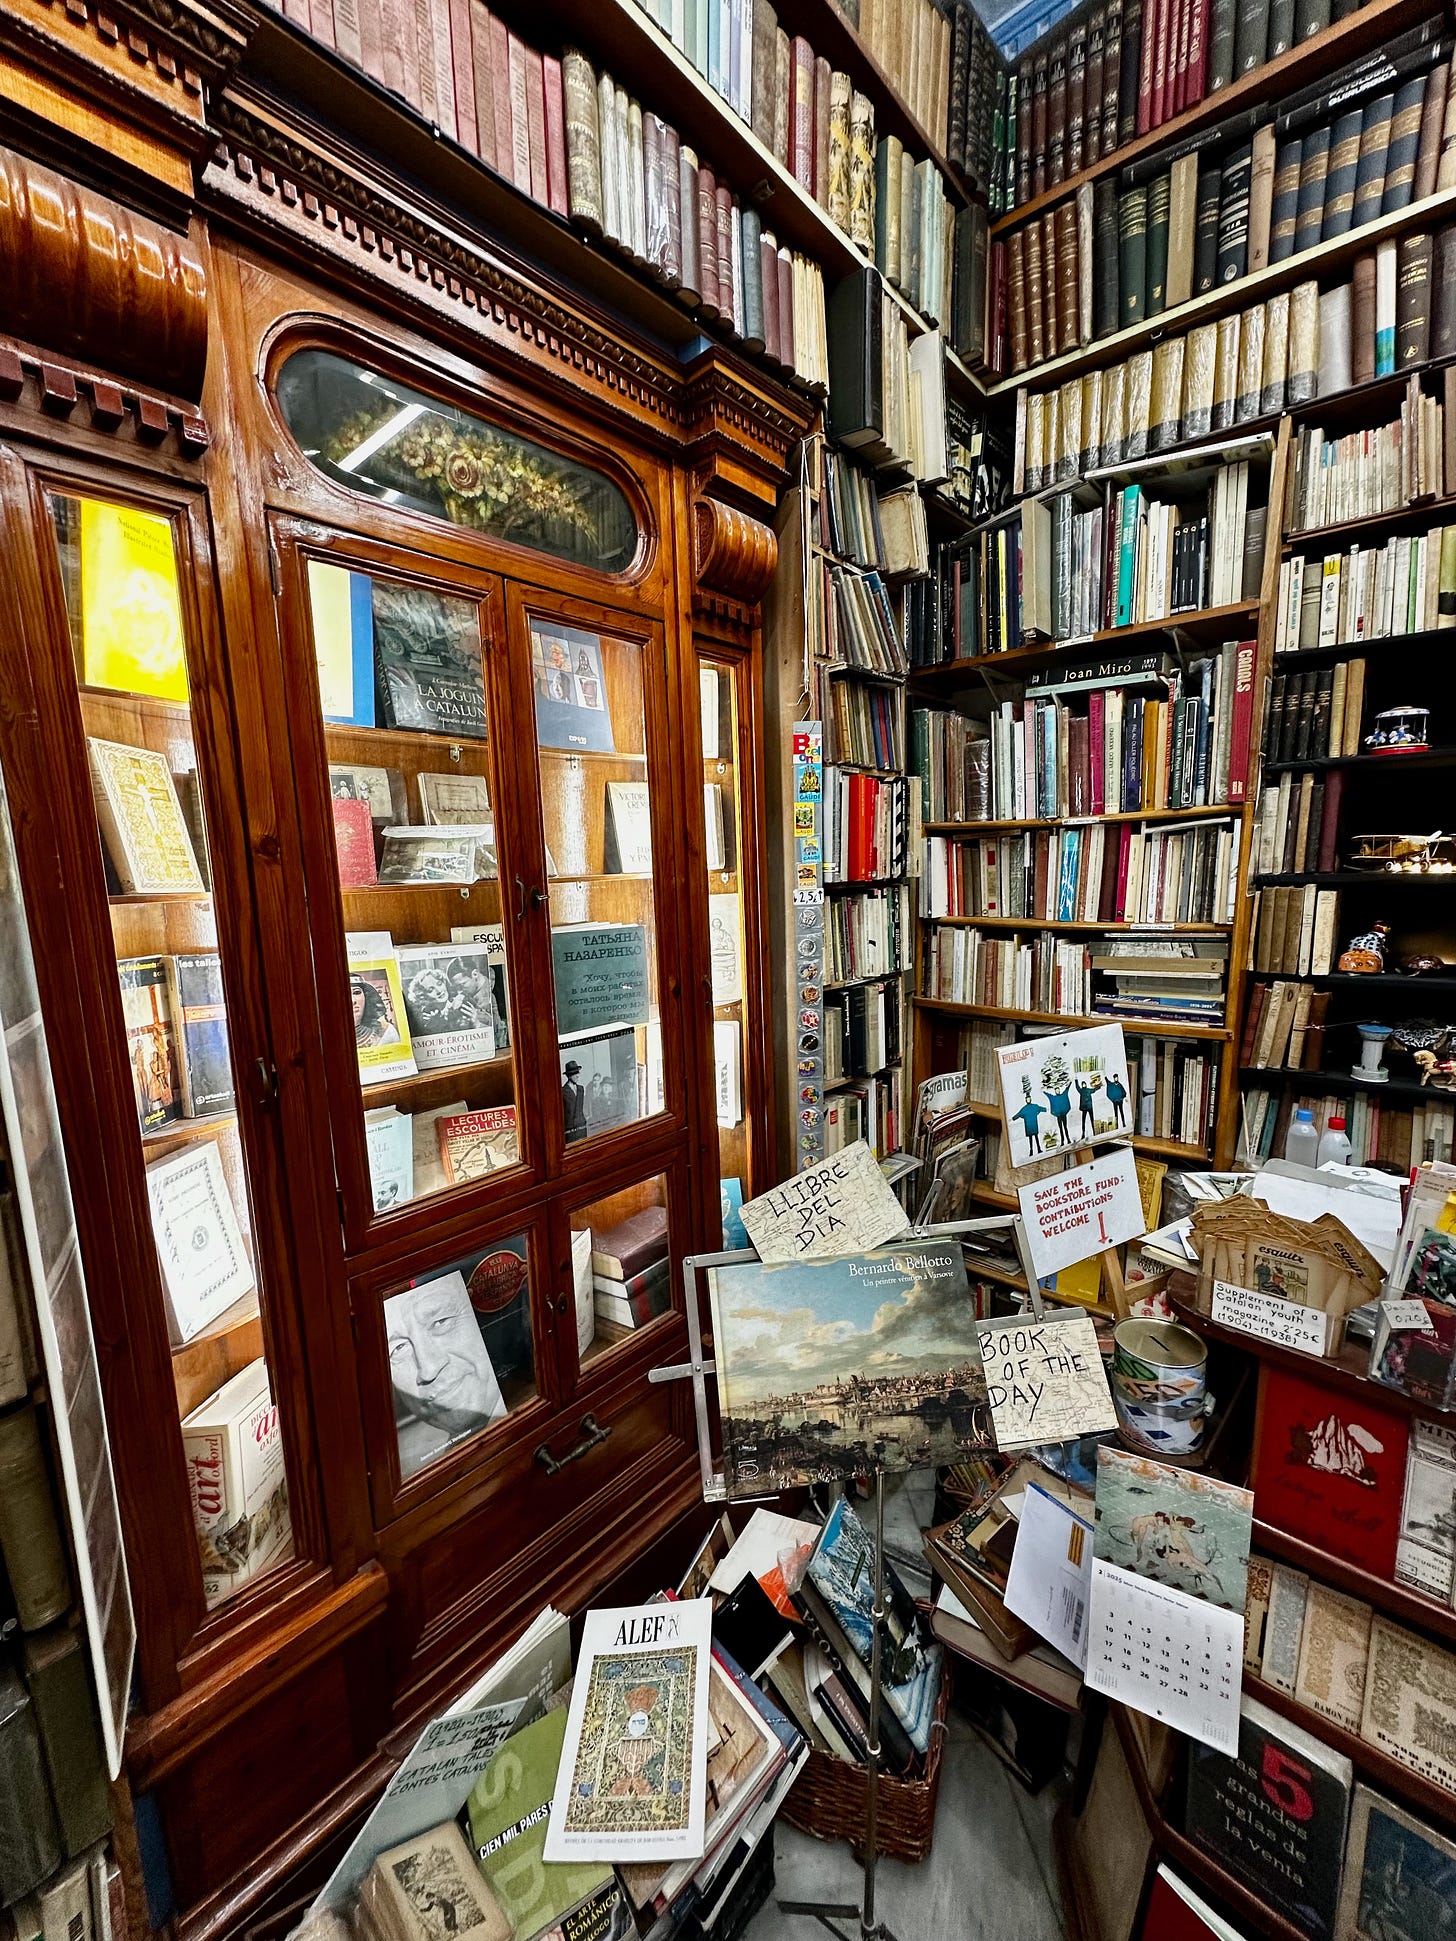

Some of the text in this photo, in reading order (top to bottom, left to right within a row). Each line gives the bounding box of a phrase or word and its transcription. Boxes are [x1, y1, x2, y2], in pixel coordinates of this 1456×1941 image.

[1063, 659, 1132, 683] Joan Miró
[417, 684, 486, 703] LA JOGUIN
[414, 700, 487, 719] A CATALUN
[564, 945, 642, 962] НАЗАРЕНКО
[582, 931, 641, 947] ТАТЬЯНА
[426, 1042, 476, 1058] ET CINÉMA
[447, 1118, 516, 1136] ESCOLLIDES
[452, 1110, 508, 1127] LECTURES
[767, 1163, 850, 1218] LLIBRE
[1034, 1177, 1083, 1201] SAVE THE
[1036, 1175, 1125, 1213] BOOKSTORE FUND:
[797, 1194, 842, 1230] DEL
[1042, 1213, 1090, 1239] WELCOME
[795, 1216, 846, 1251] DIA
[473, 1261, 518, 1285] CATALUNYA
[848, 1254, 953, 1278] Bernardo Bellotto
[863, 1278, 874, 1288] Un
[875, 1275, 897, 1289] peintre
[898, 1273, 923, 1284] vénitien
[928, 1269, 954, 1280] Varsovie
[1216, 1282, 1318, 1321] Supplement of a
[1216, 1291, 1304, 1325] Catalan youth
[1223, 1305, 1275, 1328] magazine
[978, 1328, 1048, 1362] BOOK
[1003, 1354, 1089, 1381] OF THE
[988, 1382, 1044, 1422] DAY
[1107, 1572, 1122, 1584] 2025
[614, 1615, 666, 1646] ALEF
[803, 1611, 842, 1671] GOYA
[1105, 1625, 1114, 1633] 10
[1124, 1633, 1132, 1641] 11
[1142, 1641, 1151, 1649] 12
[1181, 1658, 1190, 1666] 14
[1201, 1667, 1210, 1675] 15
[1221, 1676, 1230, 1684] 16
[1103, 1654, 1188, 1697] 24 25 26 27 28
[1123, 1648, 1131, 1656] 18
[1142, 1656, 1150, 1664] 19
[1160, 1665, 1170, 1673] 20
[1179, 1673, 1188, 1681] 21
[1200, 1682, 1209, 1690] 22
[1219, 1691, 1229, 1700] 23
[1315, 1702, 1342, 1721] RAMON
[1377, 1731, 1419, 1761] Resum
[1391, 1749, 1405, 1762] de
[398, 1749, 494, 1783] CATALAN TALES
[1230, 1758, 1258, 1780] as
[389, 1773, 439, 1797] CONTES
[1262, 1744, 1313, 1820] 5
[1226, 1777, 1307, 1840] grandes
[479, 1835, 502, 1860] CIEN
[502, 1825, 521, 1846] MIL
[520, 1805, 549, 1833] PARES
[1216, 1789, 1307, 1863] reglas de
[1225, 1816, 1304, 1888] la venta
[566, 1900, 598, 1932] EL ARTE
[569, 1890, 620, 1941] ROMÁNICO
